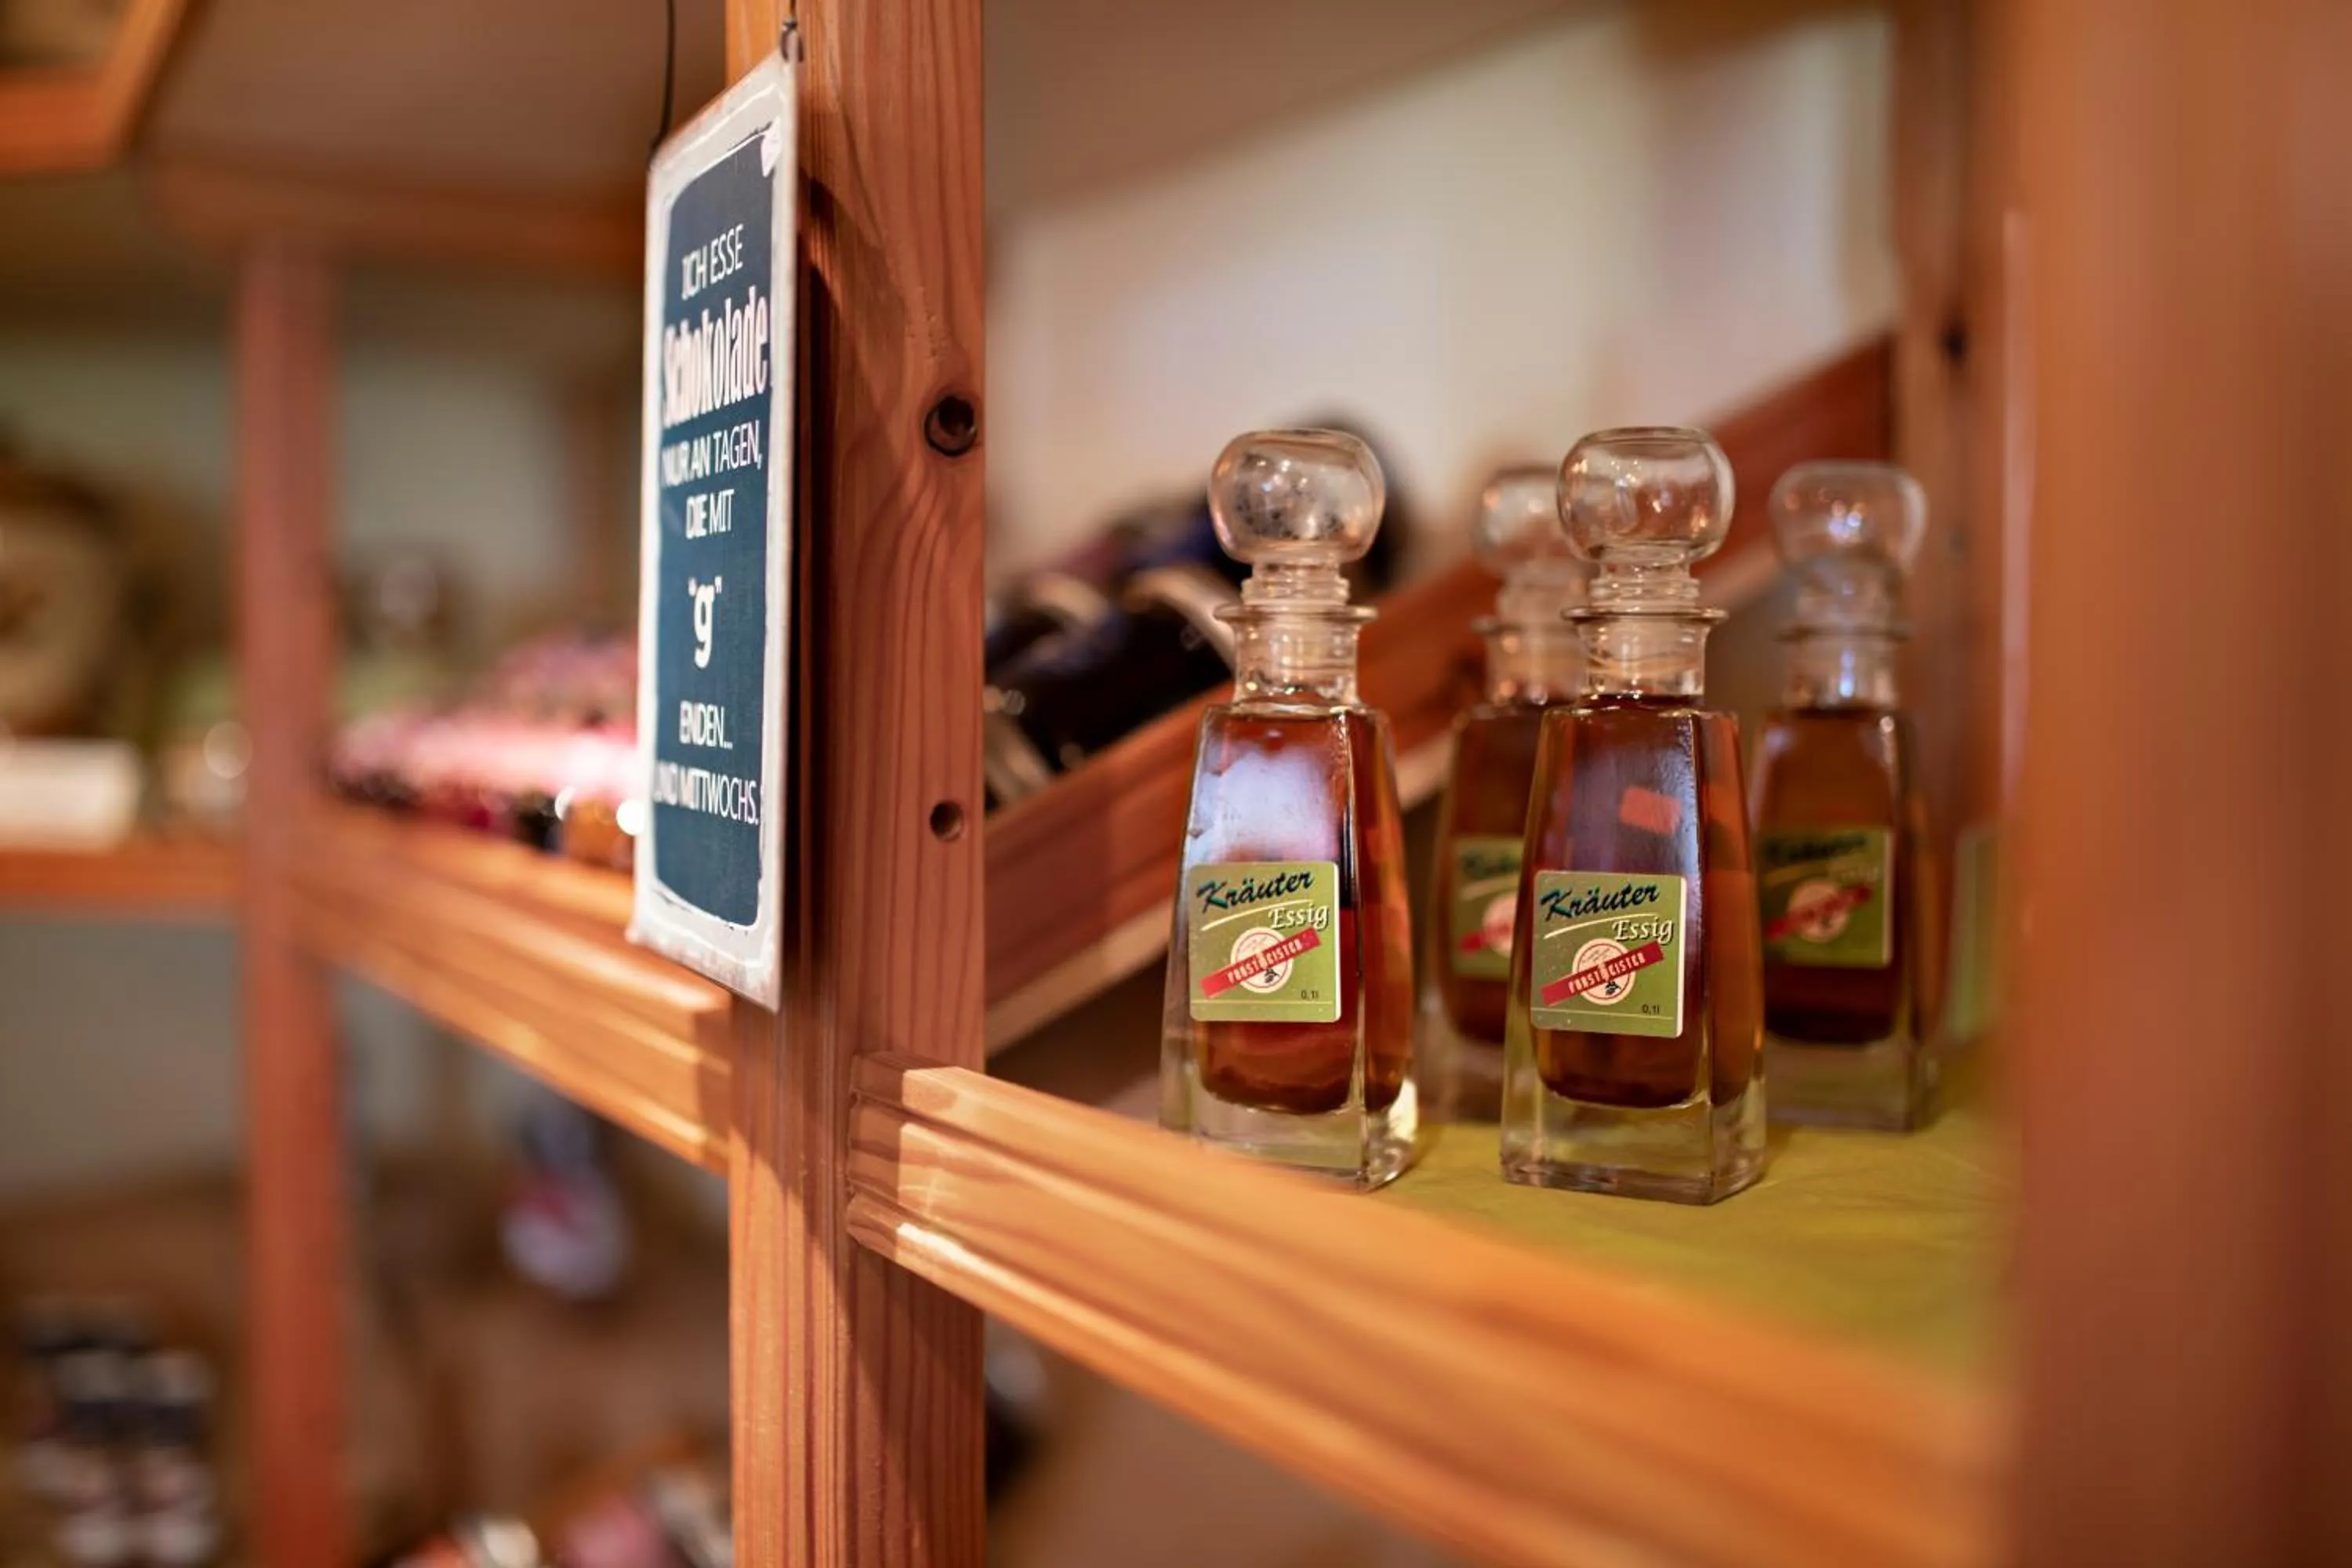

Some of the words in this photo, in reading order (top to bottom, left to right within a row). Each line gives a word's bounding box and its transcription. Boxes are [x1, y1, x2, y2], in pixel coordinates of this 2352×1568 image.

[681, 245, 706, 301] ICH
[710, 223, 744, 284] ESSE
[663, 285, 768, 428] Schokolade
[661, 440, 691, 488] NUR
[690, 434, 710, 478] AN
[713, 419, 763, 470] TAGEN,
[685, 492, 707, 539] DIE
[709, 488, 735, 535] MIT
[680, 764, 760, 825] MITTWOCHS.
[1196, 870, 1315, 914] Kräuter
[1268, 902, 1330, 931] Essig
[1540, 882, 1660, 922] Kräuter
[1611, 916, 1675, 946] Essig
